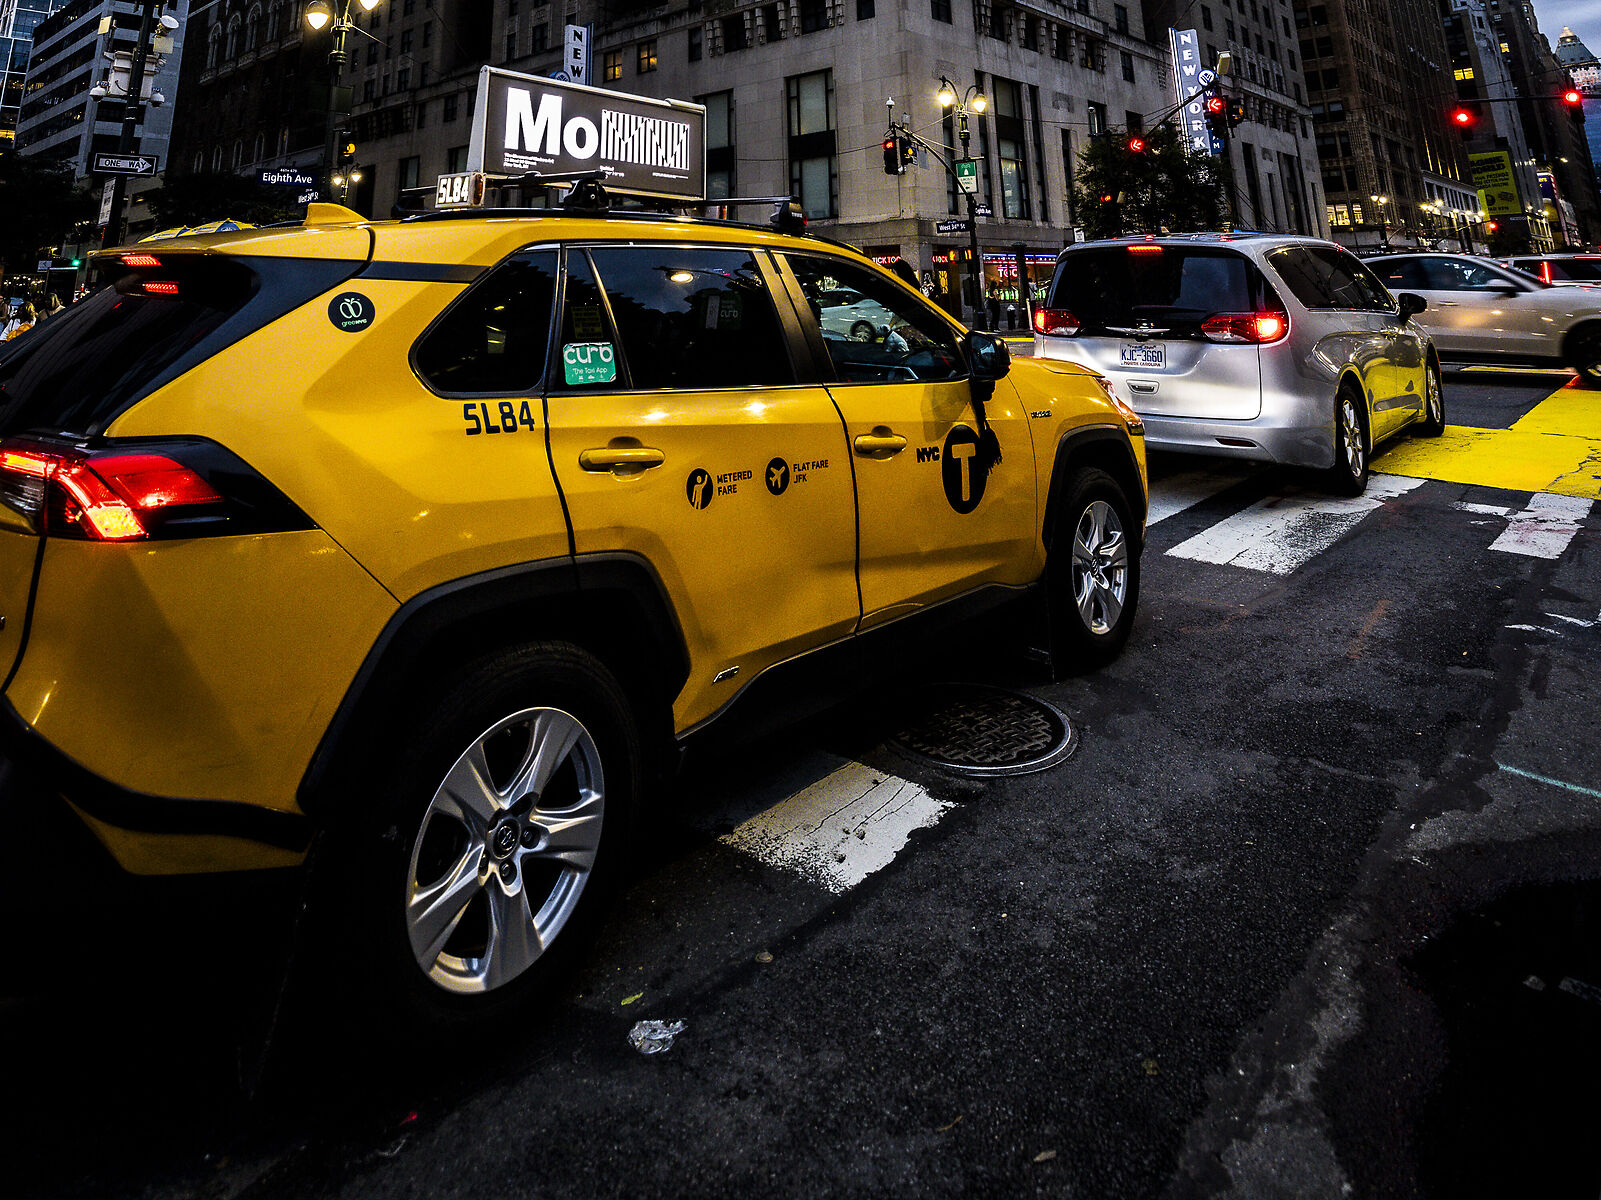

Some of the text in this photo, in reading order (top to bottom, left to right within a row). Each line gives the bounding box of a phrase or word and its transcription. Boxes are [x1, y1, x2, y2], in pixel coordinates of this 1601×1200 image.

[1180, 33, 1206, 149] NEW YORK
[104, 159, 147, 169] ONE WAY
[262, 172, 313, 184] Eighth Ave
[438, 176, 470, 204] 5L84
[872, 256, 887, 264] TICK
[564, 346, 614, 365] curb
[1121, 348, 1163, 363] KJC-3660
[463, 400, 535, 436] 5L84
[793, 459, 829, 472] FLAT FARE
[916, 442, 976, 502] NYC T
[716, 470, 753, 485] METERED
[793, 473, 808, 484] JFK
[717, 484, 738, 497] FARE
